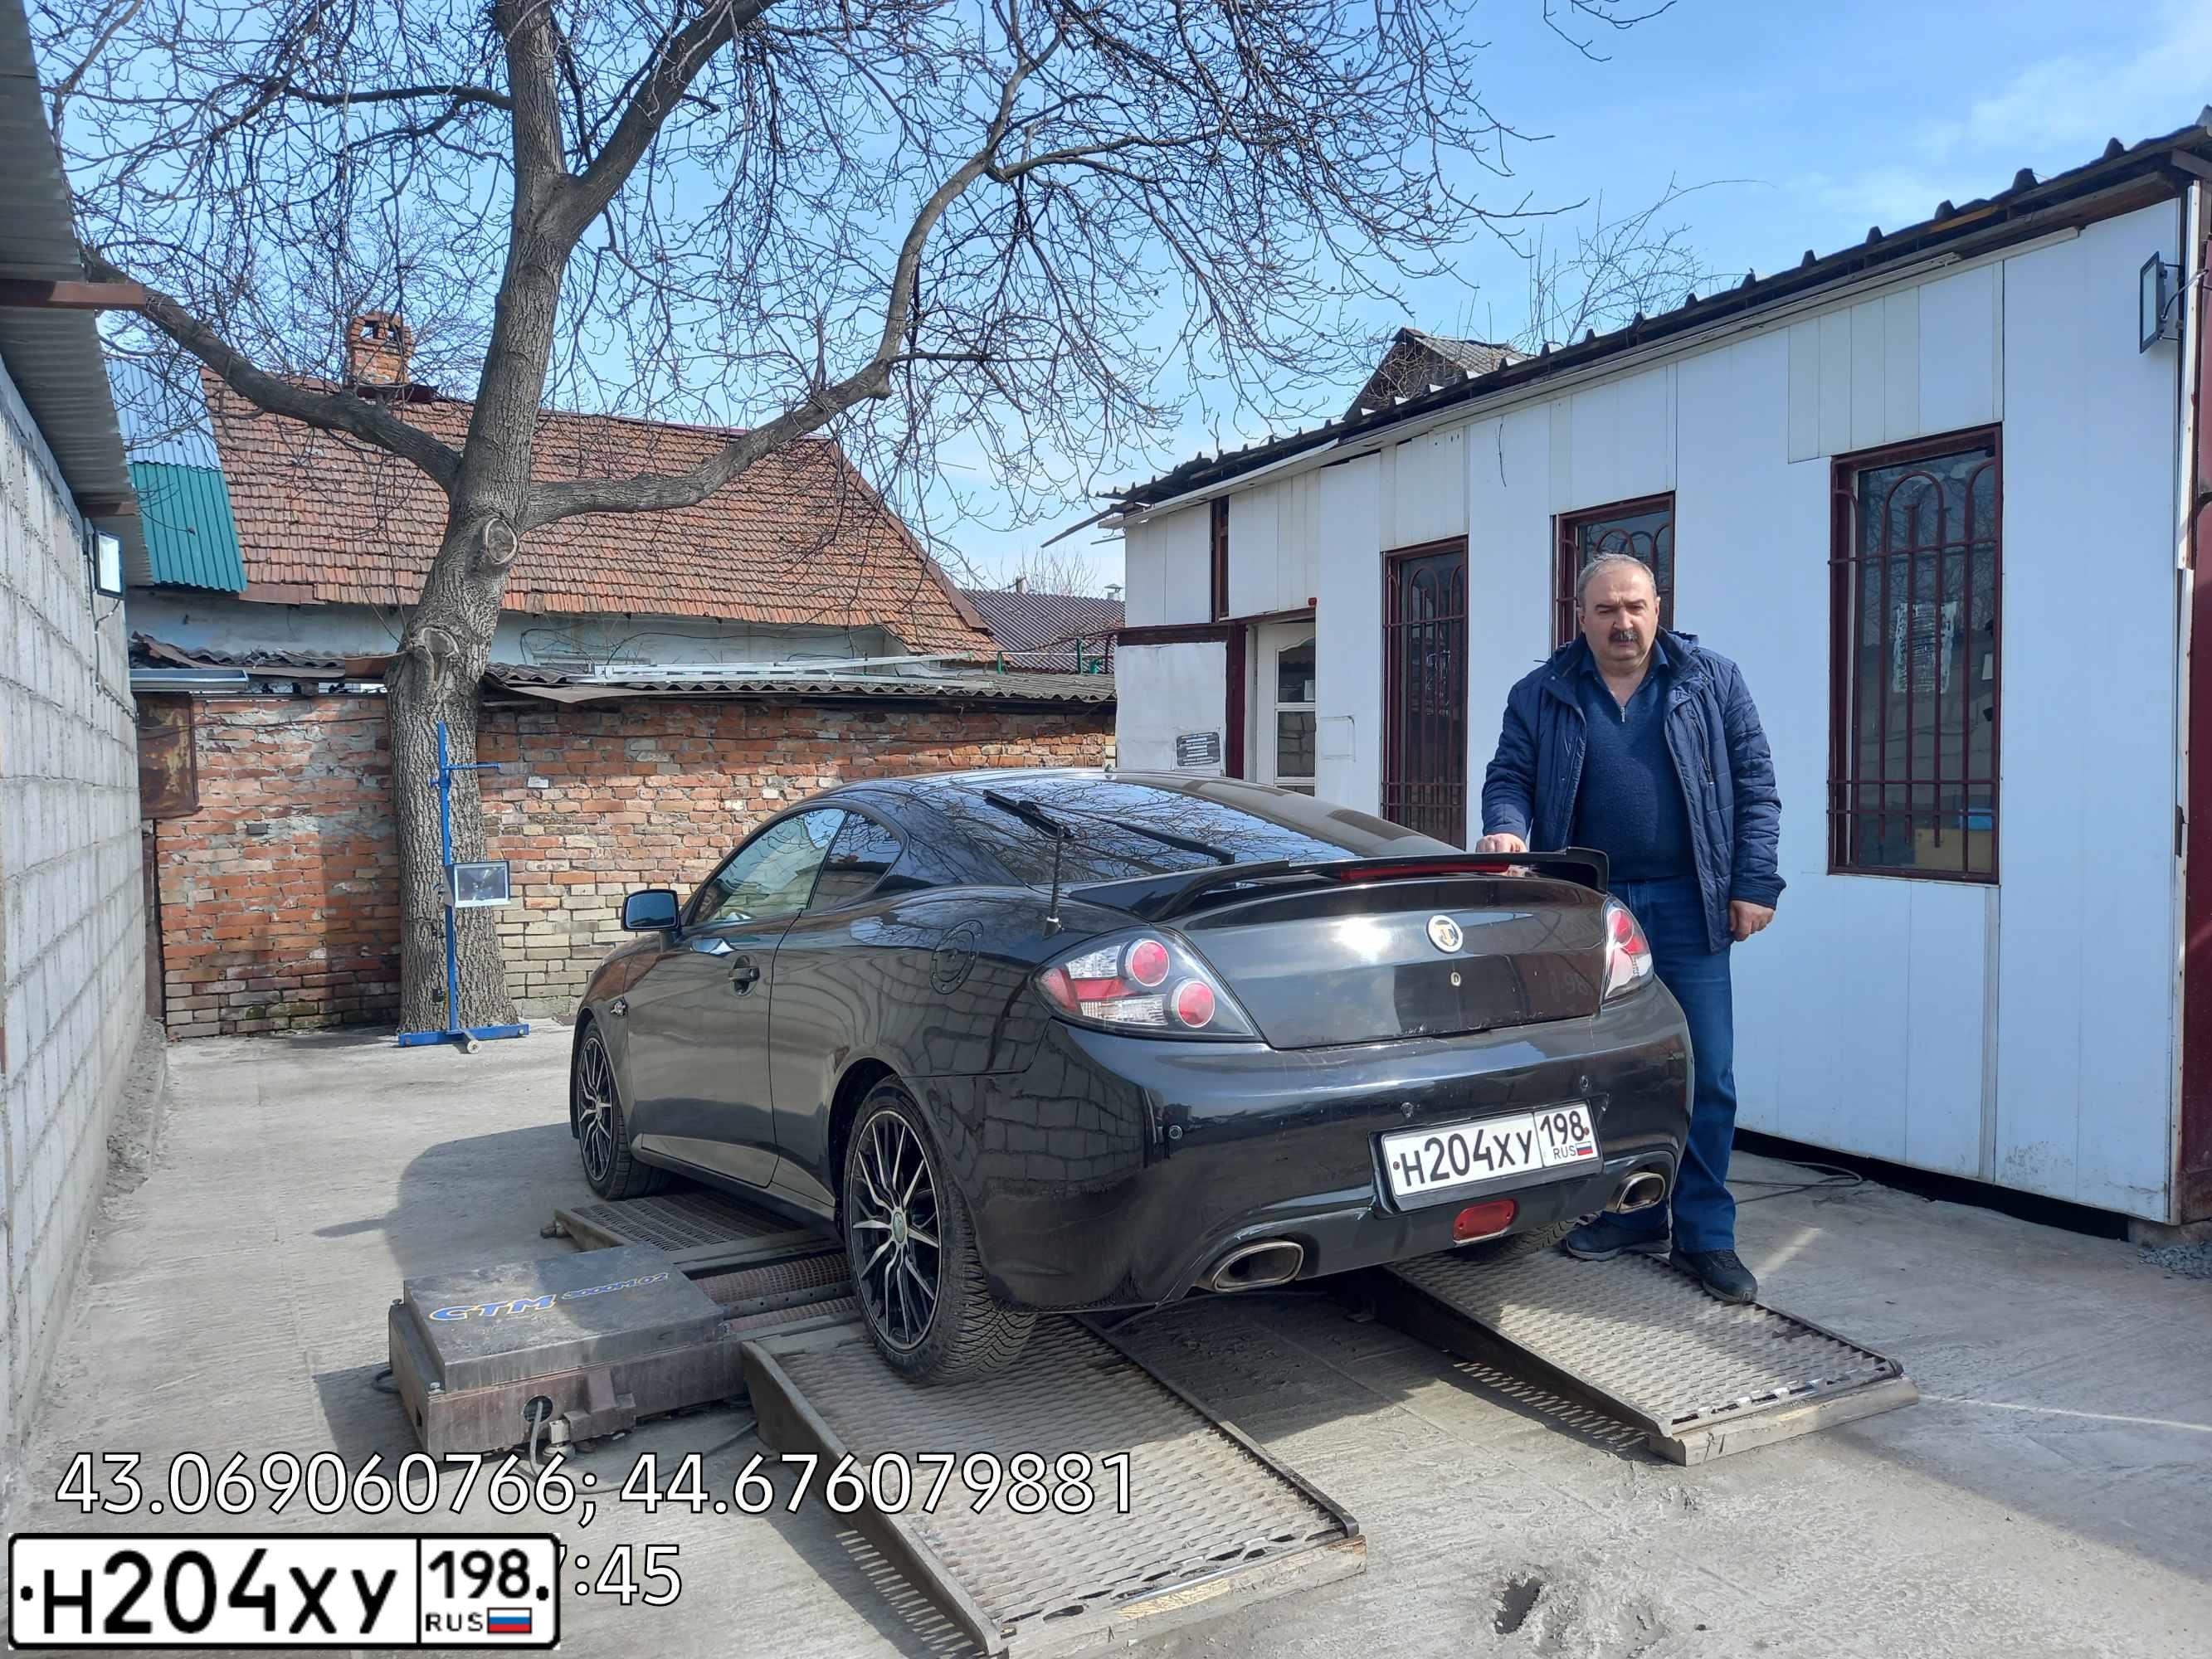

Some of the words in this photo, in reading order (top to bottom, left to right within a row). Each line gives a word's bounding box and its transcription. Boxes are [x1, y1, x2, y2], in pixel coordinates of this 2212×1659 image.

[1399, 1128, 1532, 1187] Н204ХУ
[1539, 1110, 1585, 1146] 198
[1552, 1146, 1577, 1160] RUS
